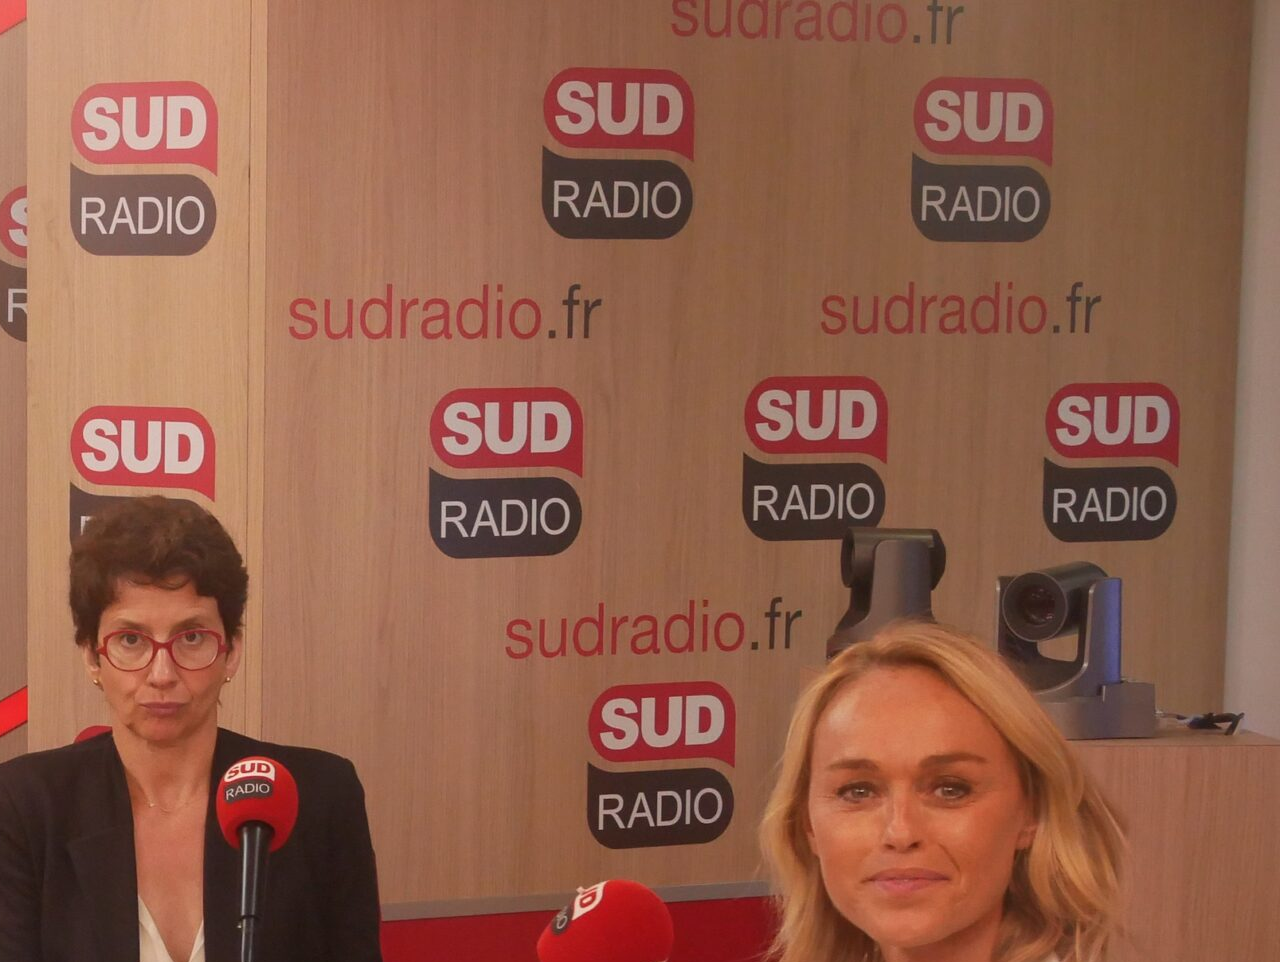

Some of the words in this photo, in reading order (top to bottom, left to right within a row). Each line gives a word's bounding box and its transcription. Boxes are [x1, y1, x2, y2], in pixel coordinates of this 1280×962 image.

[671, 0, 963, 44] sudradio.fr
[82, 96, 207, 151] SUD
[555, 80, 683, 136] SUD
[924, 90, 1043, 142] SUD
[81, 196, 205, 235] RADIO
[552, 180, 682, 219] RADIO
[920, 185, 1040, 223] RADIO
[288, 284, 601, 340] sudradio.fr
[821, 281, 1101, 335] sudradio.fr
[441, 401, 572, 455] SUD
[755, 389, 878, 441] SUD
[1055, 395, 1170, 446] SUD
[81, 419, 205, 474] SUD
[440, 497, 570, 539] RADIO
[753, 482, 874, 521] RADIO
[1052, 485, 1167, 524] RADIO
[505, 597, 803, 659] sudradio.fr
[600, 694, 725, 750] SUD
[226, 783, 270, 800] RADIO
[227, 763, 271, 779] SUD
[598, 787, 723, 831] RADIO
